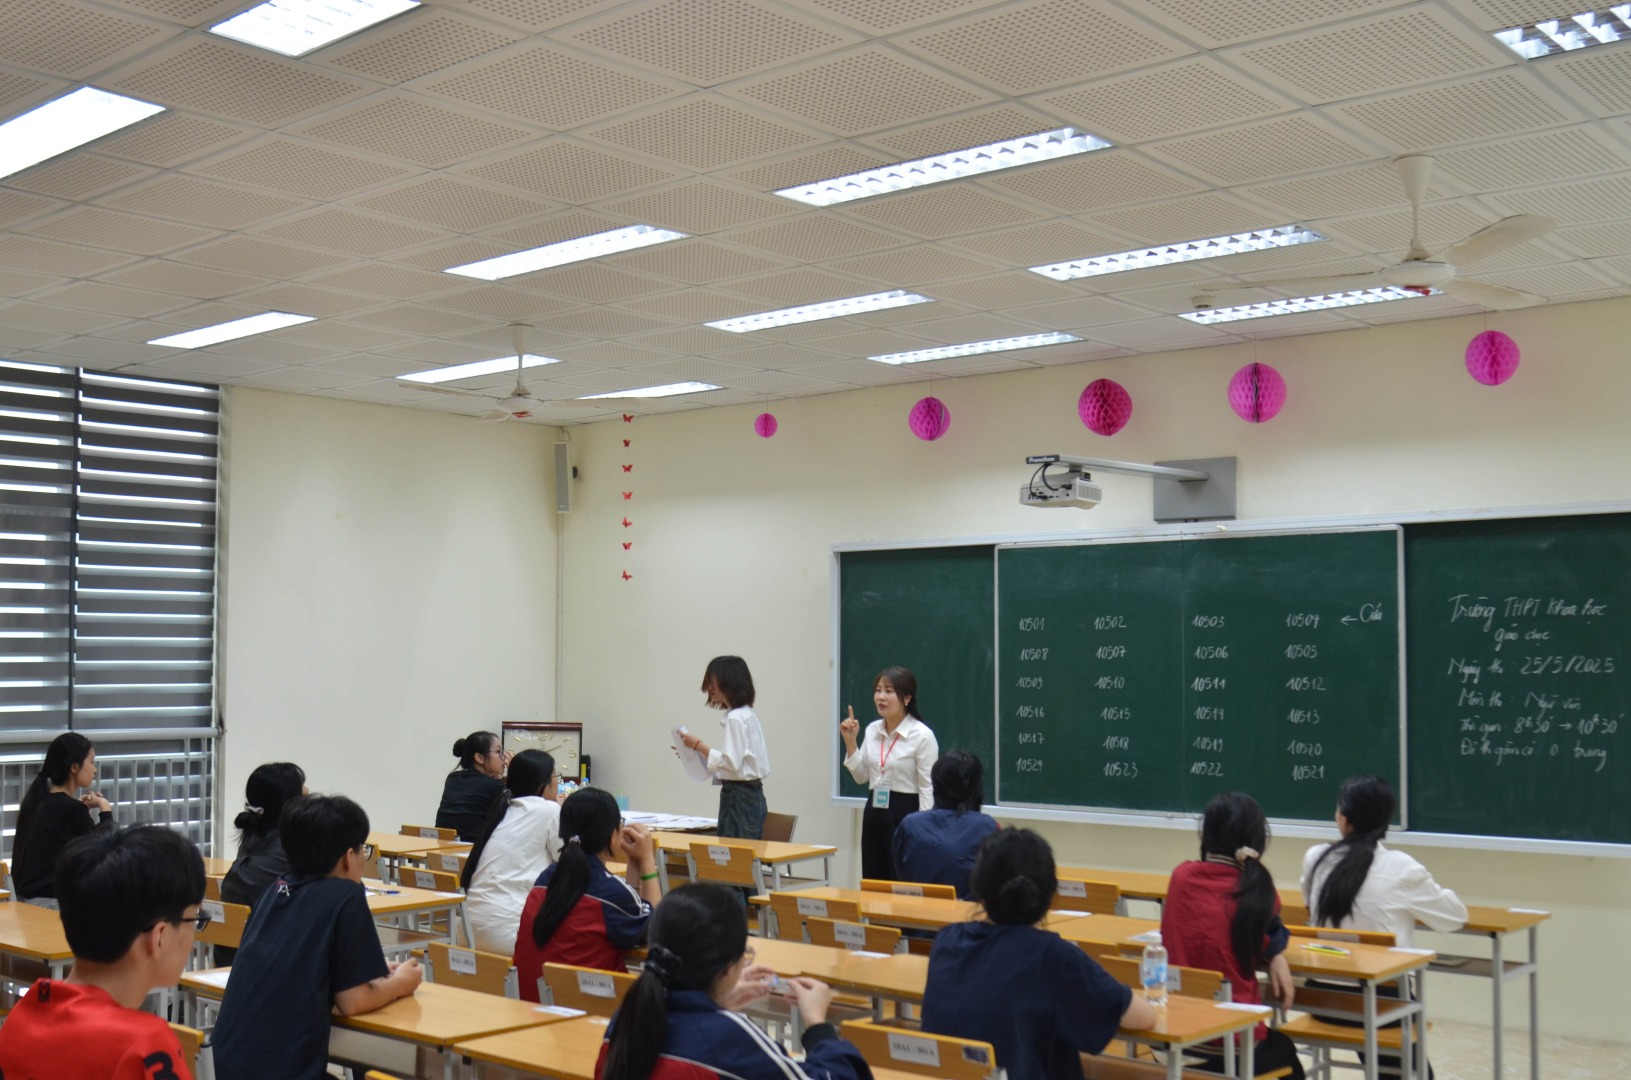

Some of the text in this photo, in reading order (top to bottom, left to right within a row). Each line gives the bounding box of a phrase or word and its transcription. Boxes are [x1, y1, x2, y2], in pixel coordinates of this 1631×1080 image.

[1504, 596, 1542, 617] THPT
[1018, 617, 1045, 631] 10501
[1093, 615, 1127, 630] 10502
[1191, 614, 1225, 628] 10503
[1018, 644, 1318, 661] 10508 10507 10506 10505
[1520, 655, 1615, 675] 25/5/2025
[1016, 676, 1327, 692] 10509 10510 10511 10512
[1016, 705, 1045, 719] 10516
[1100, 707, 1131, 720] 10515
[1017, 732, 1045, 745] 10517
[1102, 736, 1130, 750] 10518
[1192, 736, 1223, 753] 10519
[1102, 762, 1138, 778] 10523
[1189, 761, 1224, 777] 10522
[1291, 765, 1324, 782] 10521
